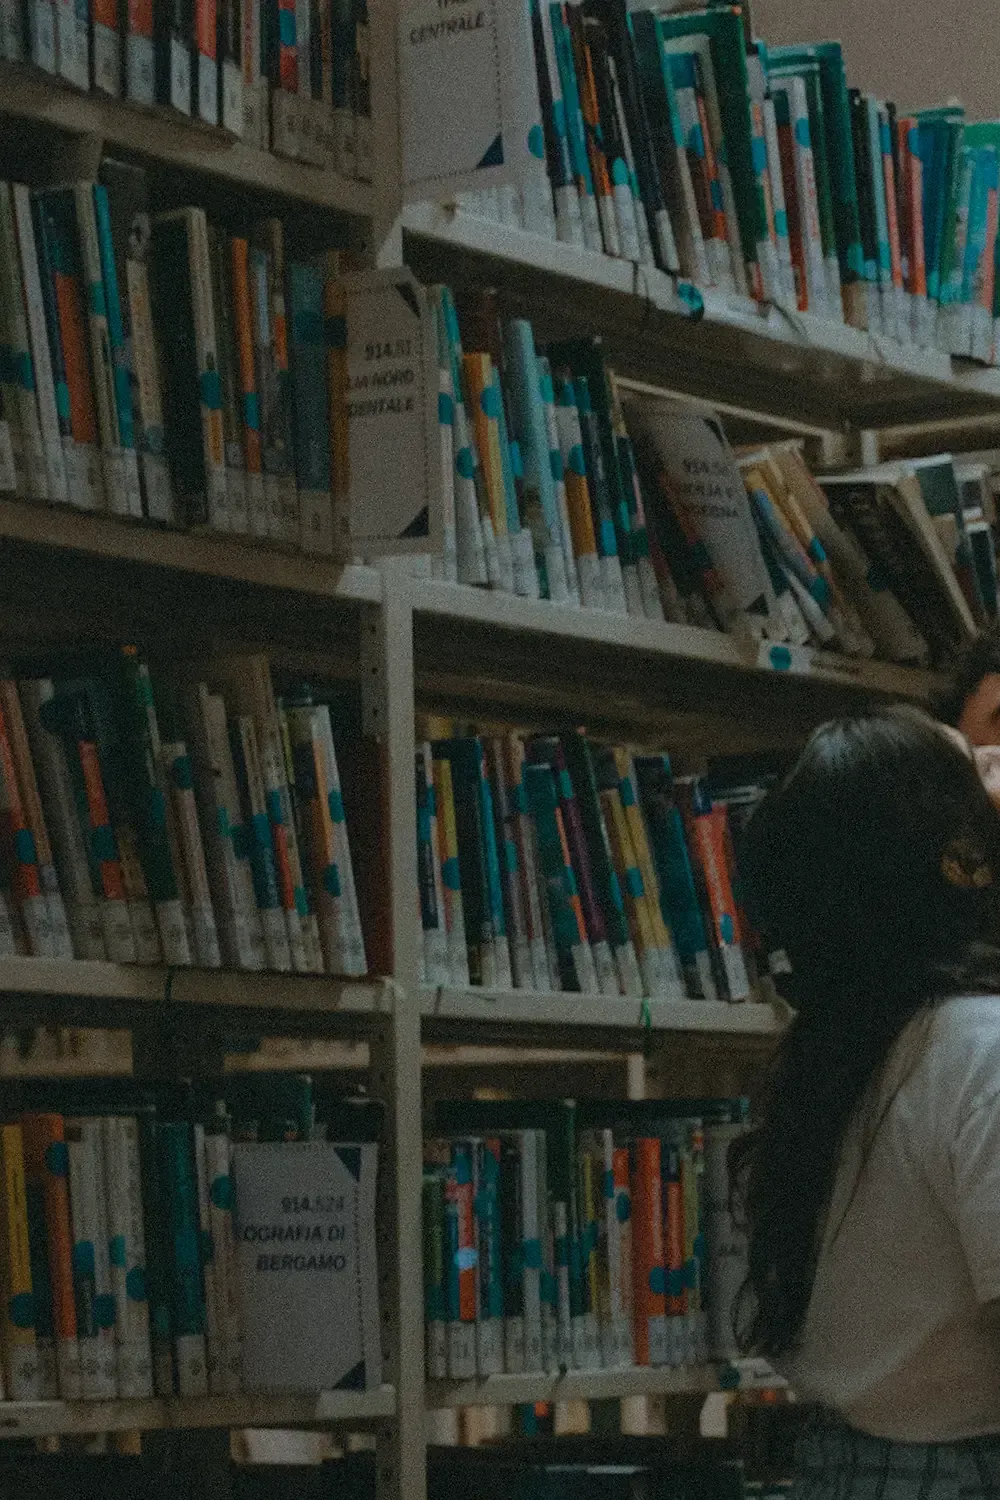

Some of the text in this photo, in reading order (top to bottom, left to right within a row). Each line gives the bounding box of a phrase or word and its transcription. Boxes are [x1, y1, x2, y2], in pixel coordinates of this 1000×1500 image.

[410, 11, 485, 45] CENTRALE
[327, 1224, 346, 1241] DI
[256, 1253, 347, 1271] BERGAMO
